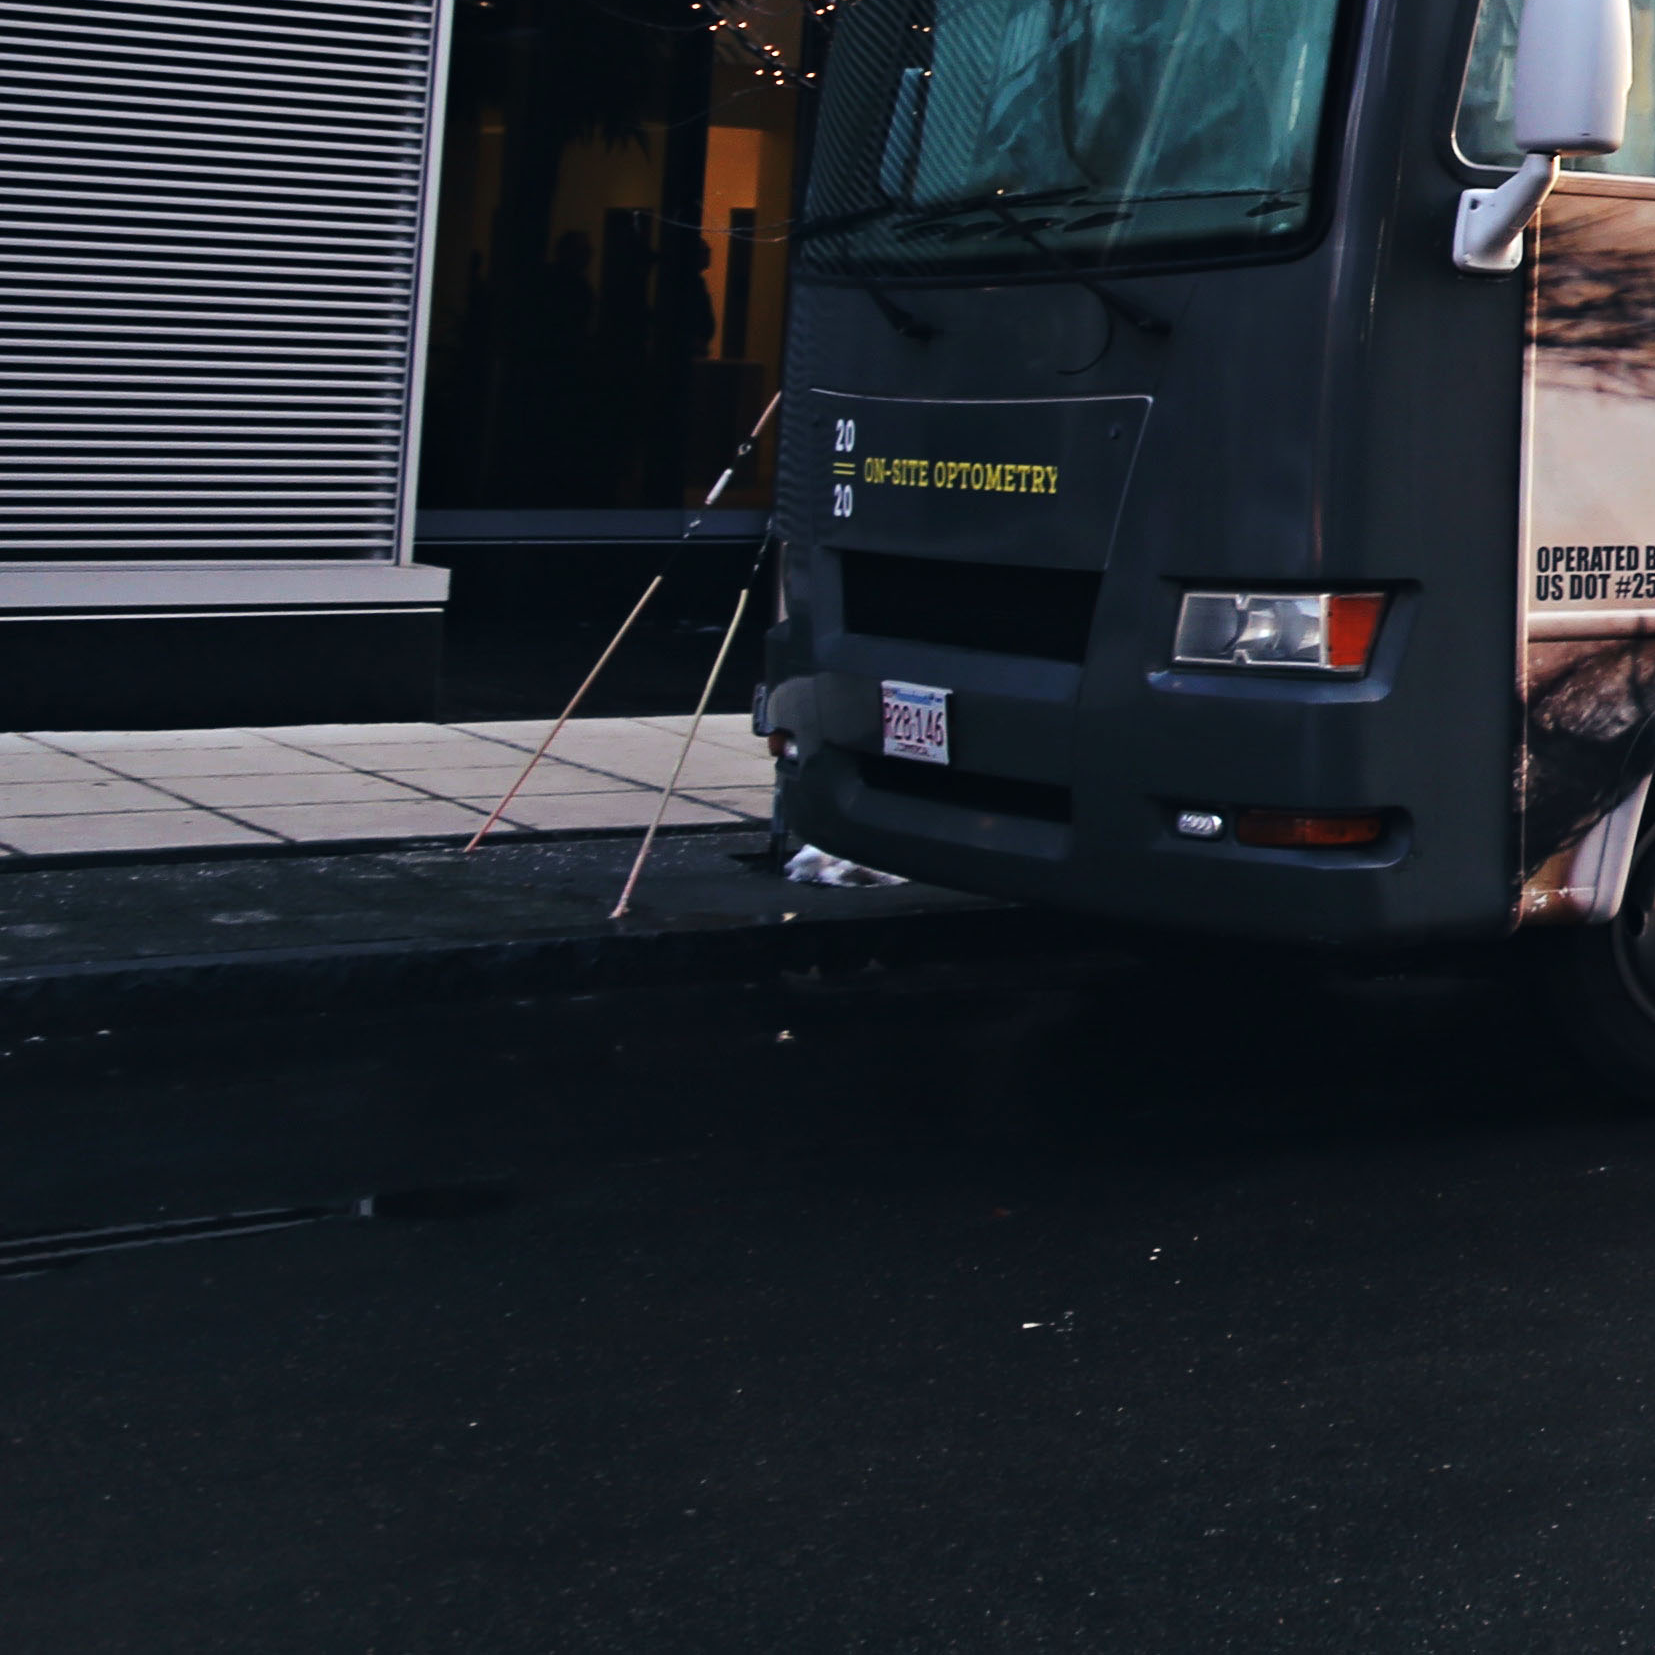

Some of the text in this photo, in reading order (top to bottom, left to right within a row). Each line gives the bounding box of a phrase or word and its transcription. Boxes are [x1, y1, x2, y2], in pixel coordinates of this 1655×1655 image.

[834, 418, 856, 452] 20
[863, 457, 1059, 494] ON-SITE OPTOMETRY
[833, 483, 853, 518] 20
[1536, 546, 1640, 573] OPERATED
[1536, 574, 1564, 601] US
[1569, 573, 1611, 600] DOT
